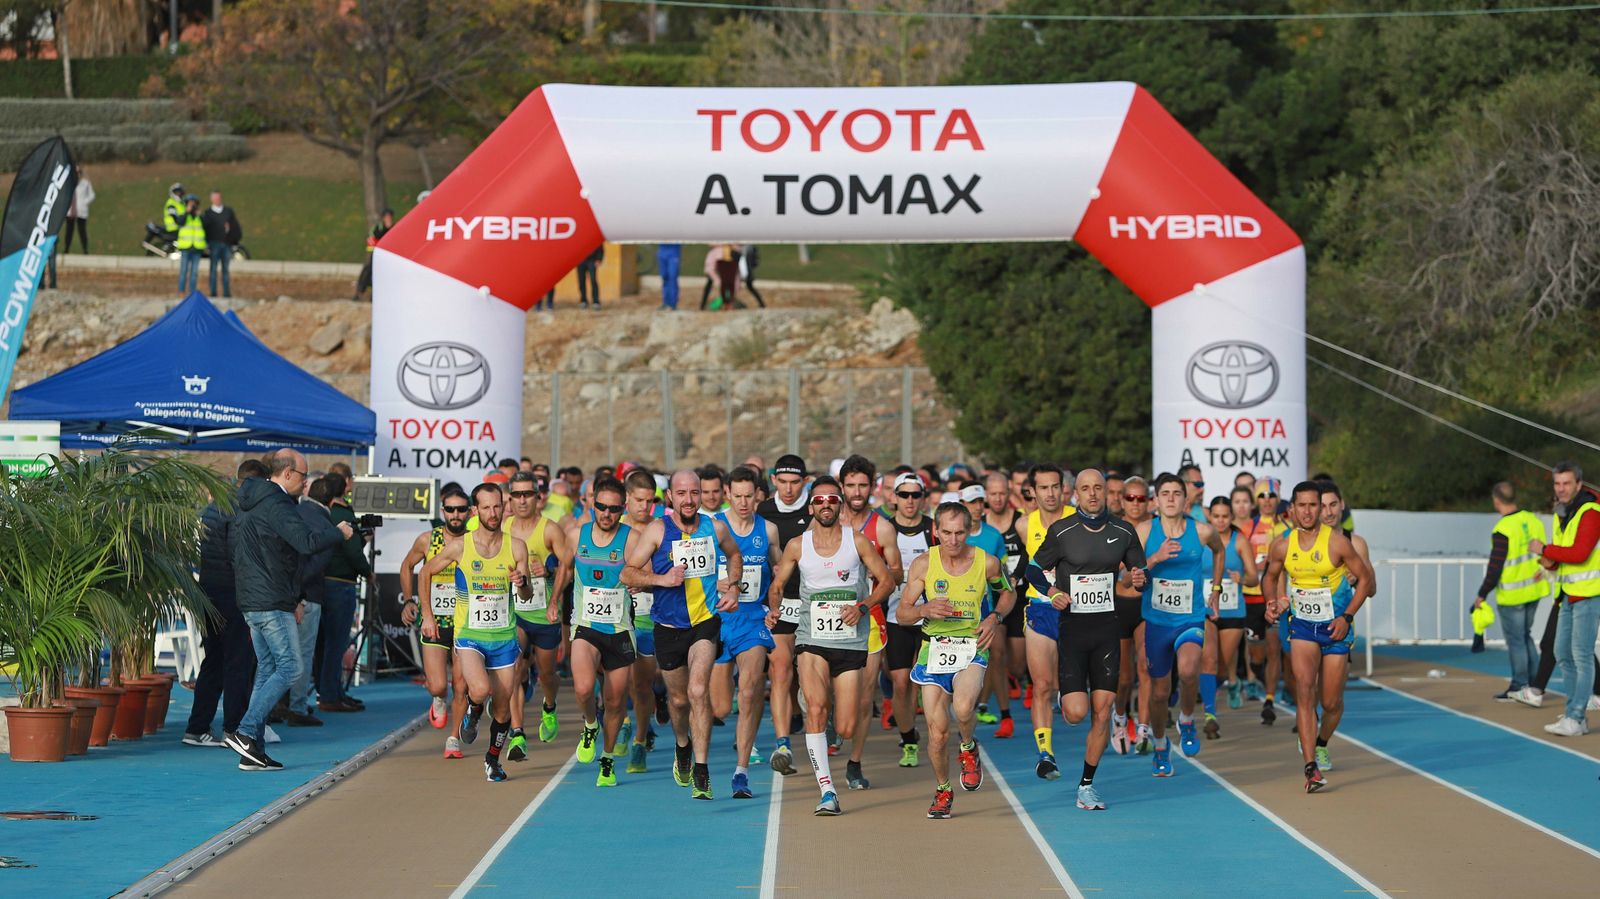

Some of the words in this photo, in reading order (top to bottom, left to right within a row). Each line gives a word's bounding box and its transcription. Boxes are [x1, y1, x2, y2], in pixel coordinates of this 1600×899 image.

[697, 107, 985, 154] TOYOTA
[696, 173, 751, 216] A.
[763, 173, 983, 216] TOMAX
[426, 215, 577, 241] HYBRID
[1109, 214, 1262, 239] HYBRID
[0, 162, 72, 354] POWERADE
[144, 408, 191, 420] Delegación
[193, 409, 204, 418] de
[205, 411, 245, 423] Deportes
[389, 417, 496, 442] TOYOTA
[1180, 417, 1286, 440] TOYOTA
[387, 448, 407, 469] A.
[411, 448, 501, 469] TOMAX
[1205, 448, 1289, 468] TOMAX
[680, 556, 707, 571] 319
[434, 597, 457, 609] 259
[1075, 591, 1112, 605] 1005A
[1158, 593, 1182, 607] 148
[474, 609, 499, 622] 133
[587, 602, 612, 616] 324
[780, 605, 801, 618] 209
[1298, 602, 1321, 615] 299
[816, 618, 844, 631] 312
[938, 652, 958, 666] 39
